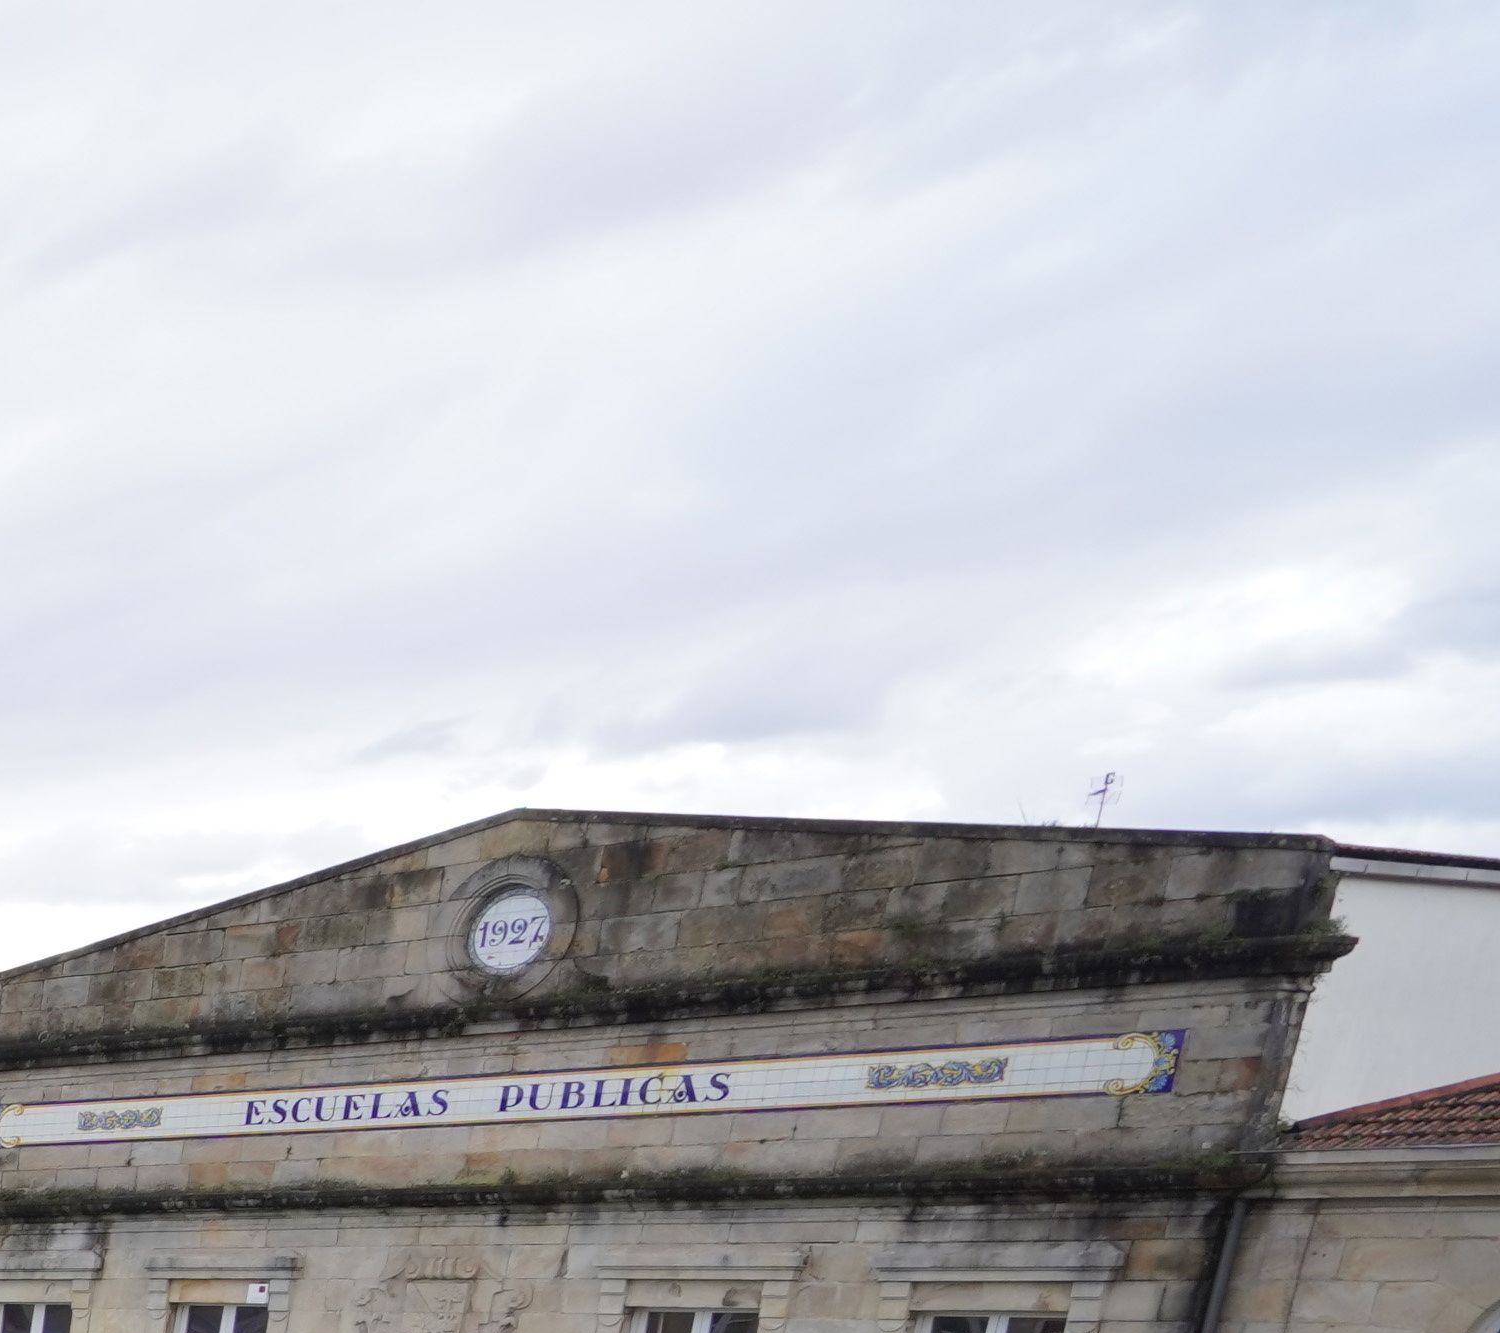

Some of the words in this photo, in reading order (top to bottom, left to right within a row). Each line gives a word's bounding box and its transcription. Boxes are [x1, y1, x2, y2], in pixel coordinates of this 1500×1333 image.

[479, 915, 548, 949] 1927
[243, 1089, 450, 1126] ESCUELAS
[497, 1072, 731, 1113] PUBLICAS
